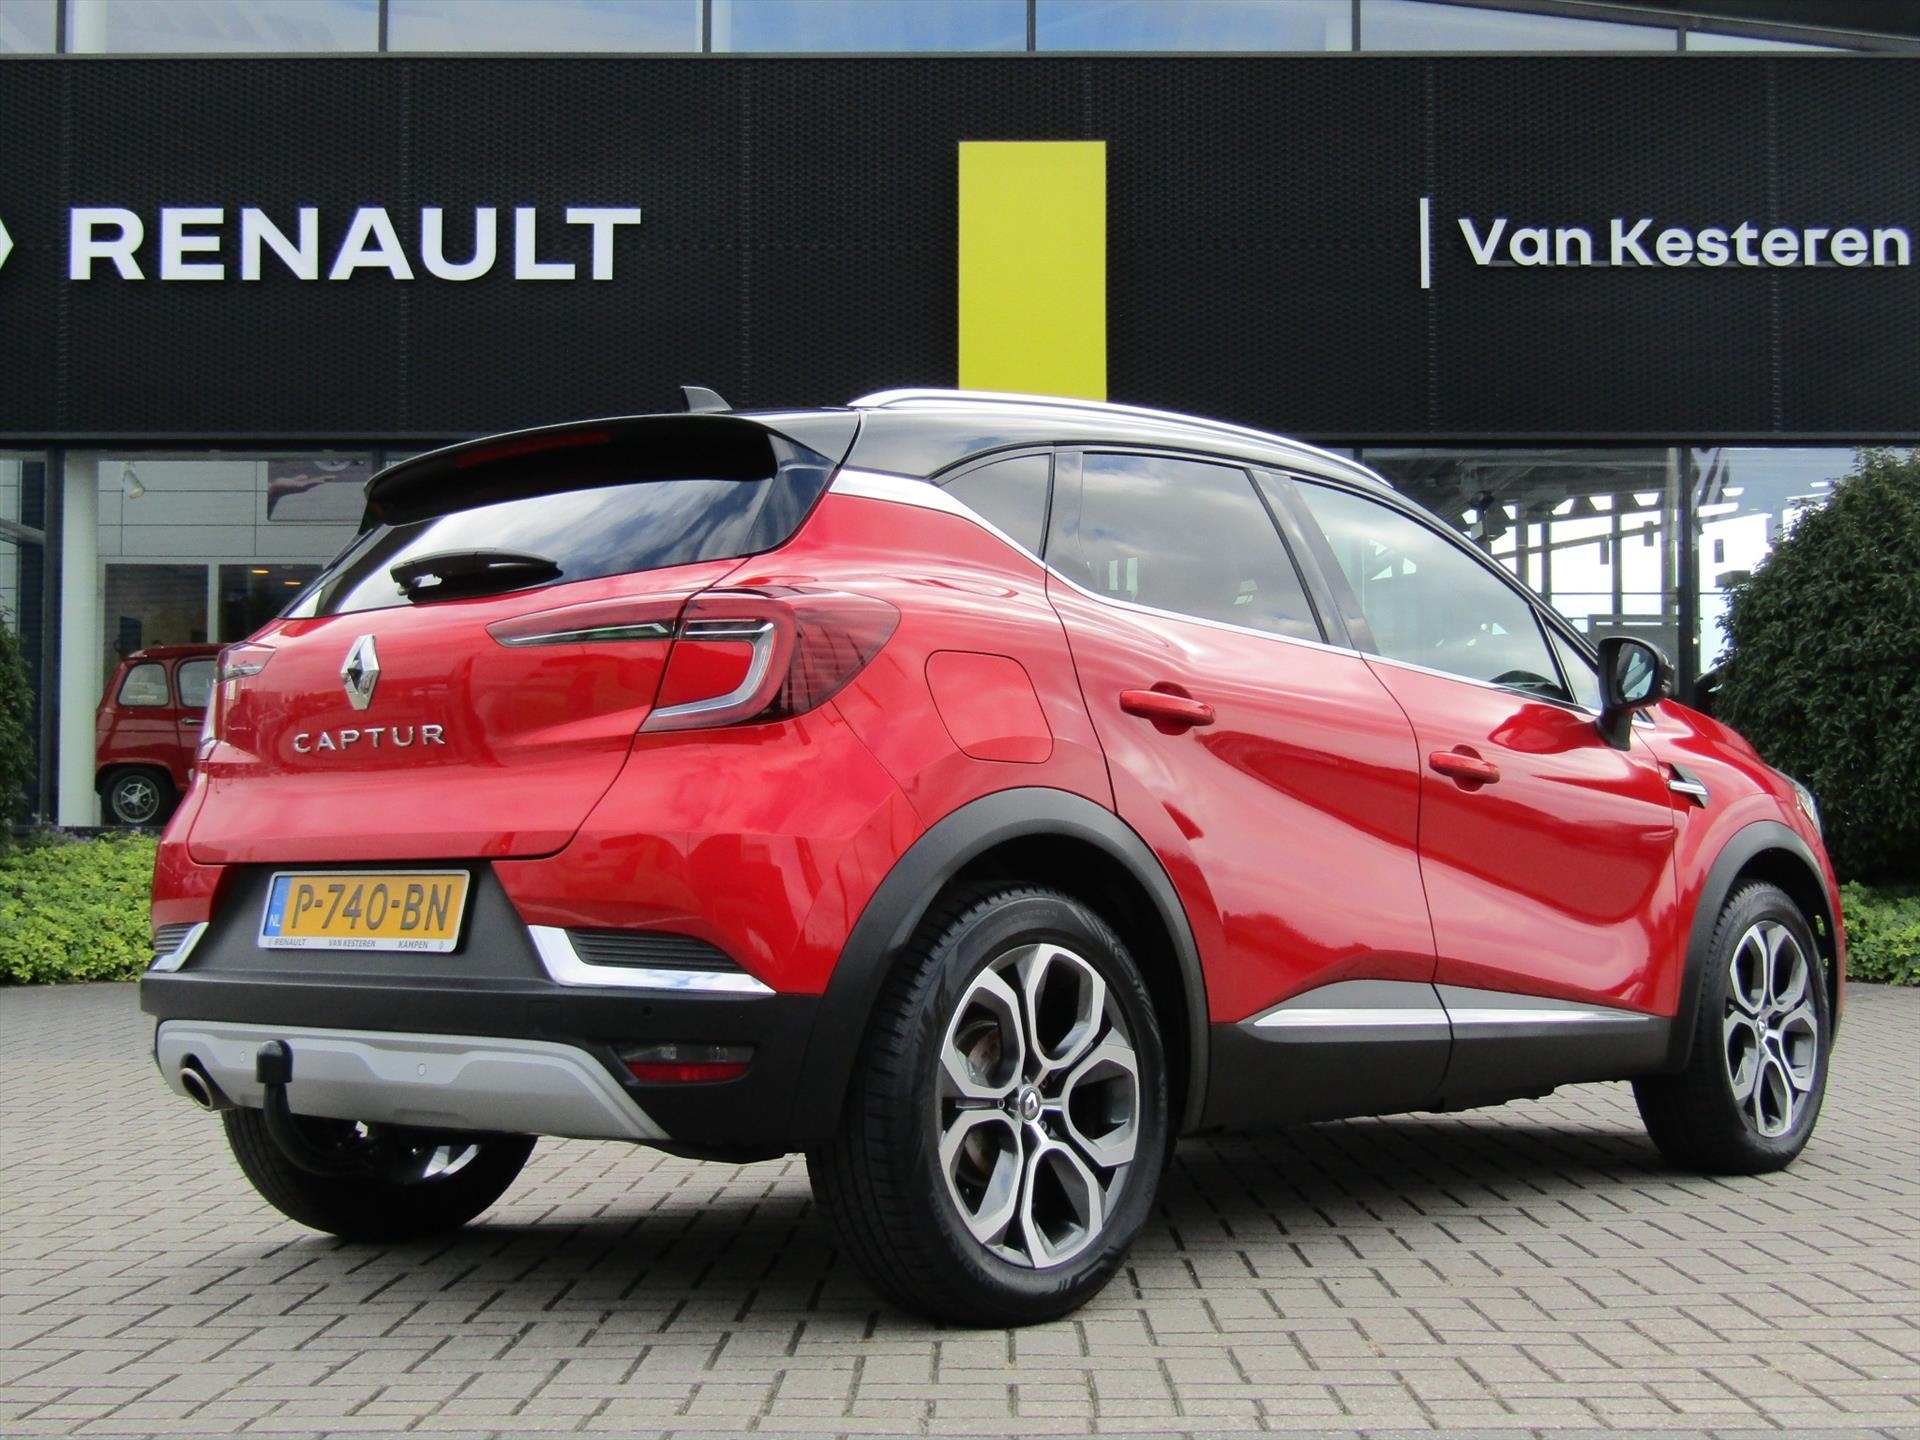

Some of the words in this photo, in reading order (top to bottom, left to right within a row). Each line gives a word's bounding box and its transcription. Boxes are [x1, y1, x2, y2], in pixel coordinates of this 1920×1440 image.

[69, 207, 642, 281] RENAULT
[1458, 218, 1592, 267] Van
[1610, 218, 1910, 267] Kesteren
[294, 724, 446, 753] CAPTUR
[269, 914, 281, 928] NL
[291, 883, 453, 932] P-740-BN
[274, 938, 307, 947] RENAULT
[328, 939, 342, 947] VAN
[343, 939, 377, 948] KESTEREN
[398, 940, 430, 949] KAMPEN
